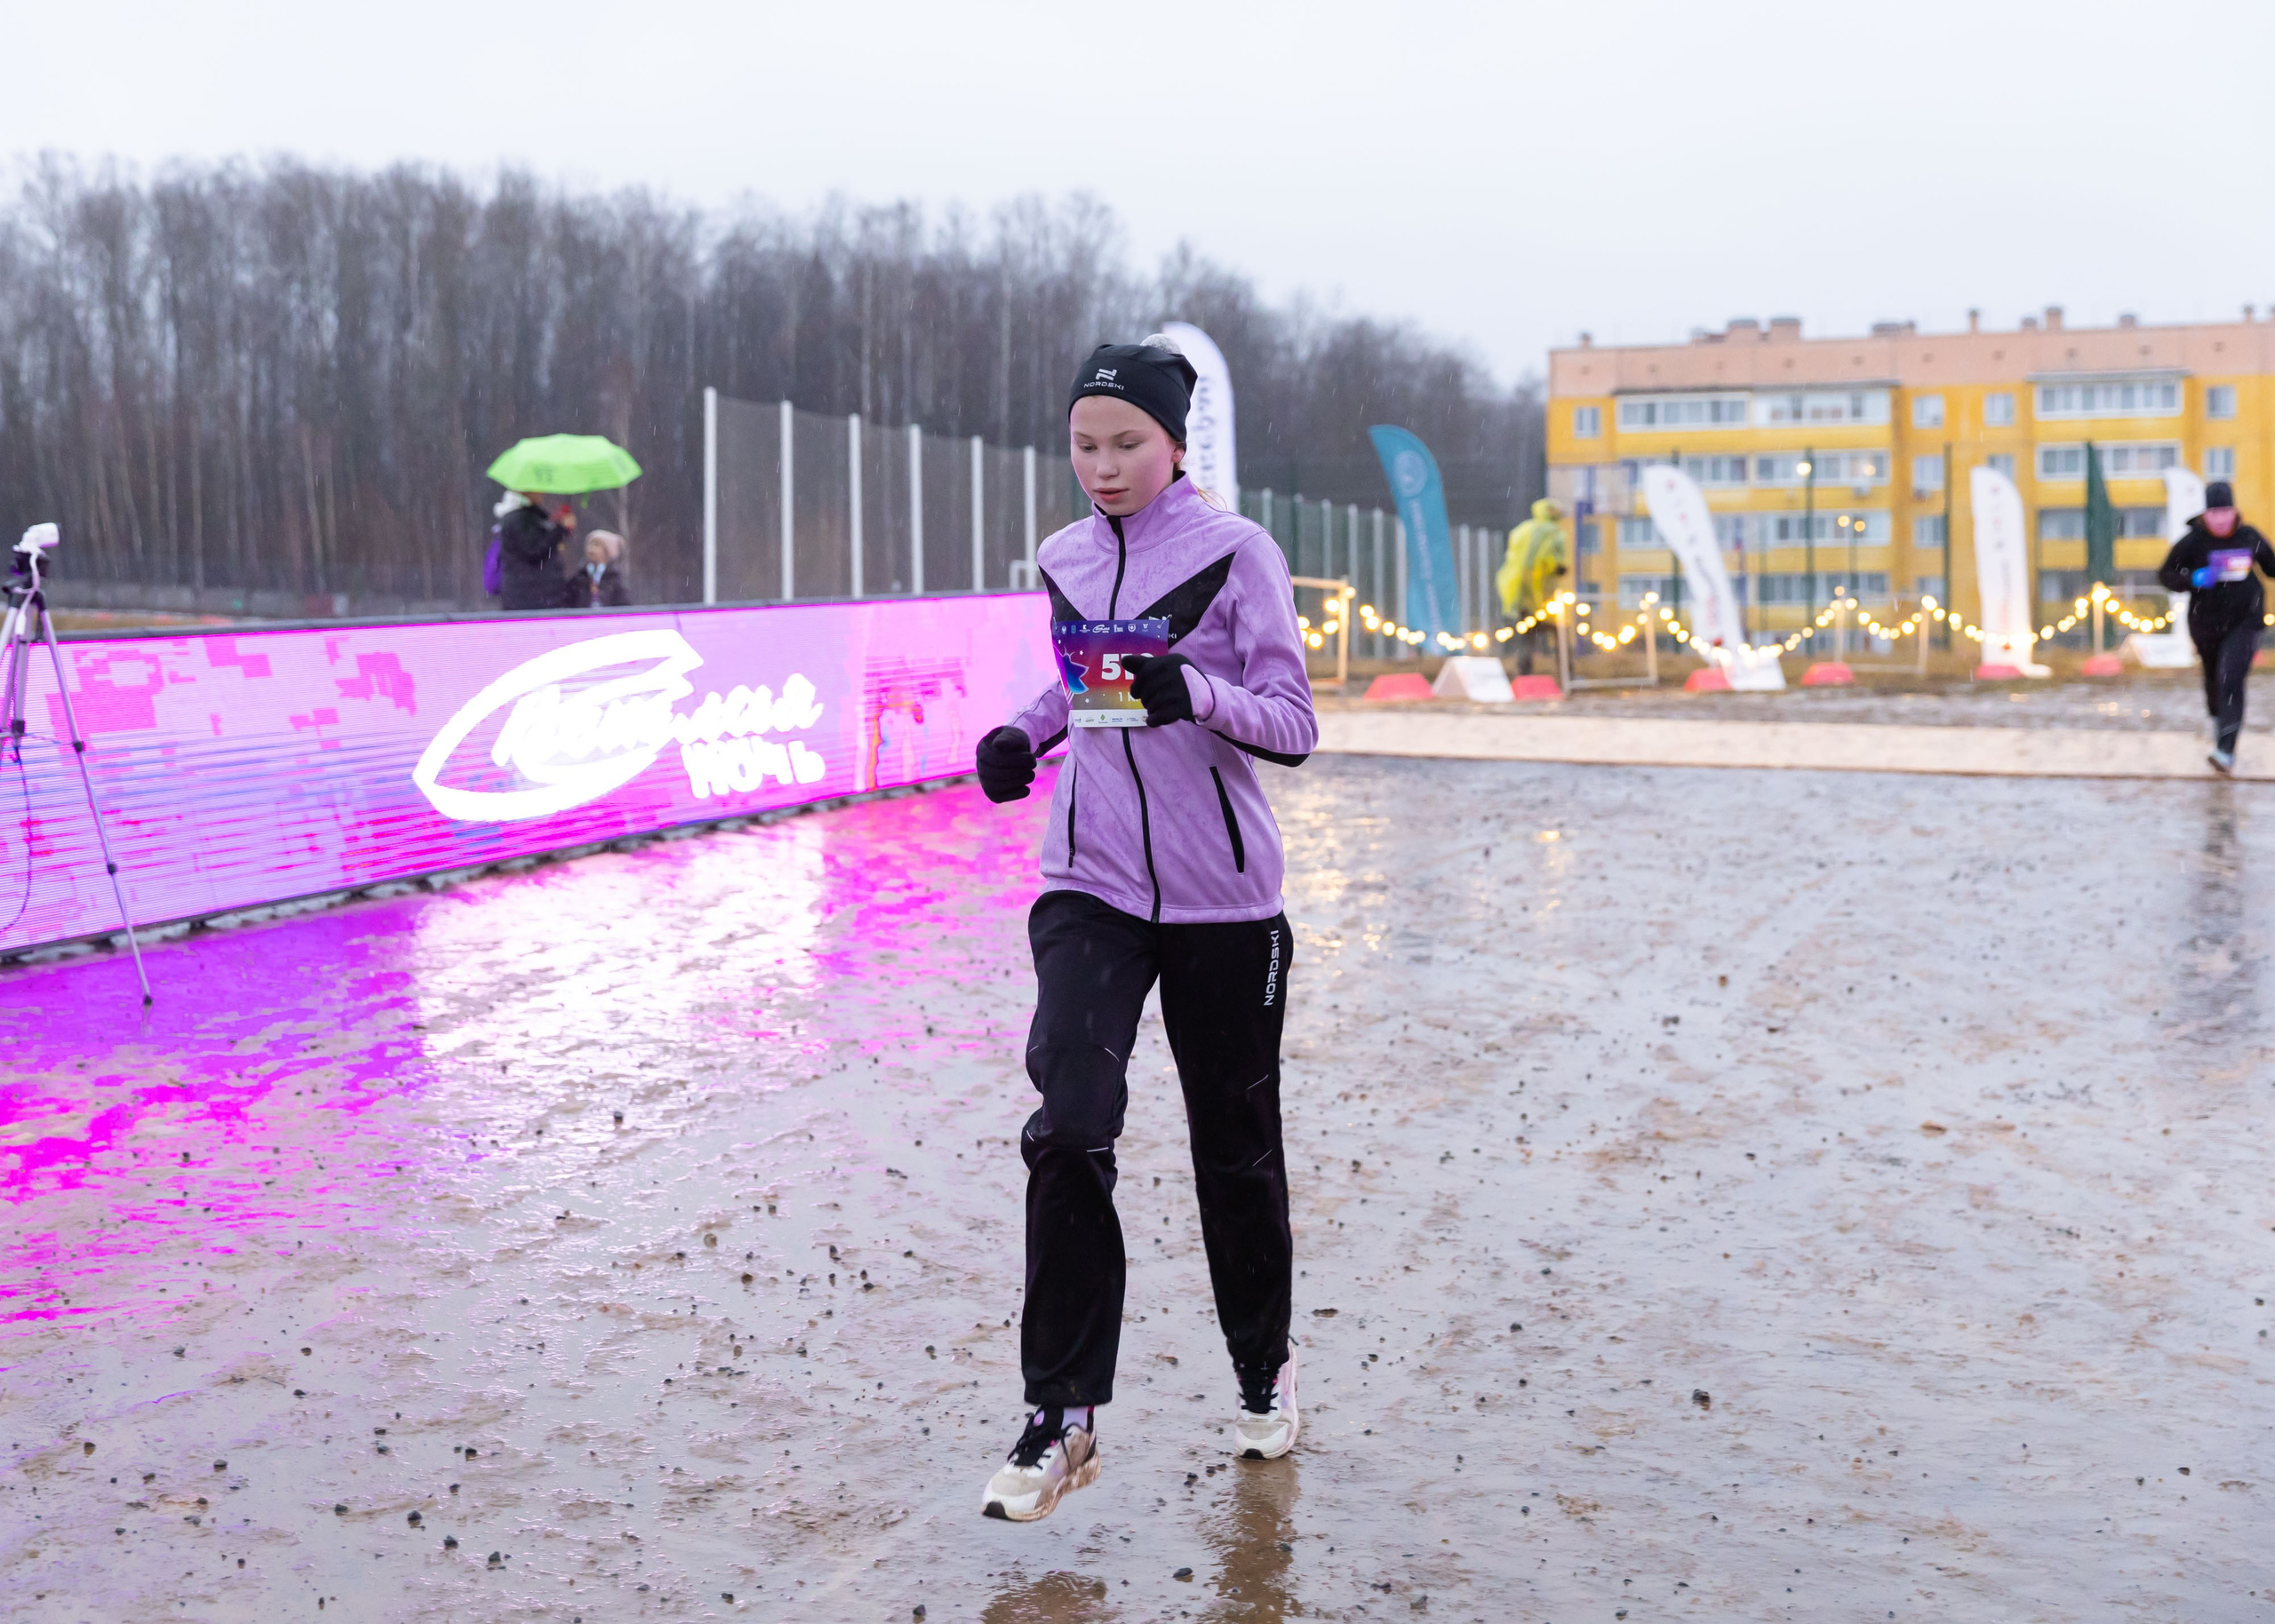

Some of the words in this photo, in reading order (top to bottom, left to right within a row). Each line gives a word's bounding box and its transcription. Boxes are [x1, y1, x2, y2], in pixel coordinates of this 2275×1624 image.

[1083, 381, 1124, 391] NORDSKI
[1101, 652, 1155, 681] 51
[1263, 929, 1280, 1006] NORDSKI
